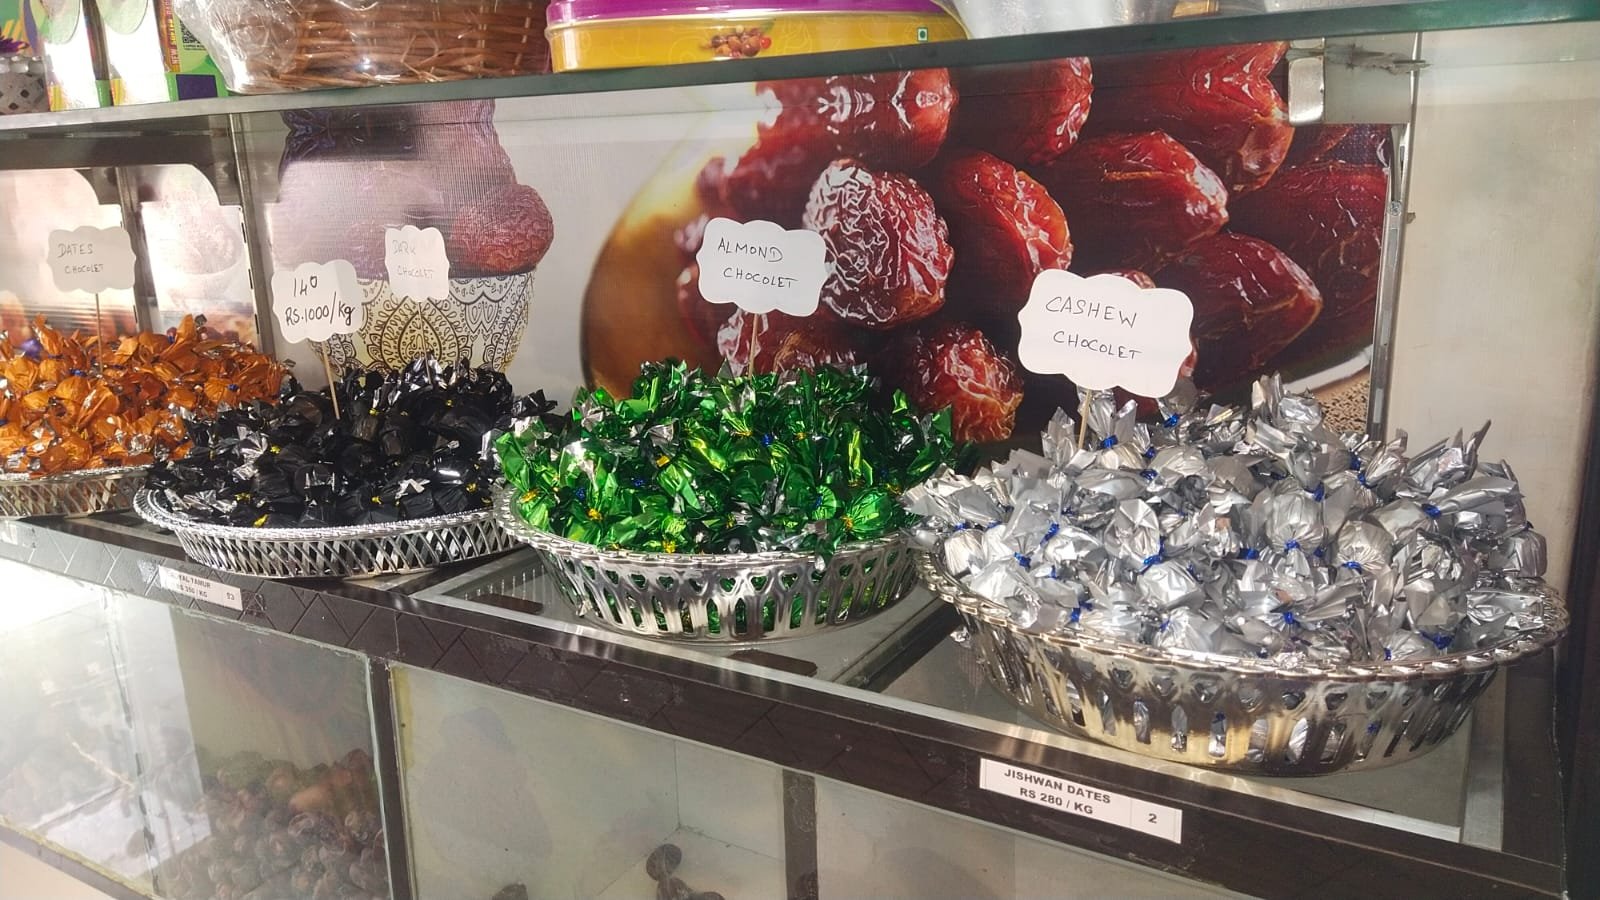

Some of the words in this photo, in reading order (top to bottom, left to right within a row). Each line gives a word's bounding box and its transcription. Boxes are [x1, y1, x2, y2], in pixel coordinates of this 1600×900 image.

[57, 243, 94, 258] DATES
[392, 239, 416, 256] DARK
[717, 236, 784, 263] ALMOND
[64, 264, 104, 274] CHOCOLET
[723, 267, 799, 289] CHOCOLET
[1045, 296, 1138, 328] CASHEW
[1053, 330, 1142, 360] CHOCOLET
[1004, 768, 1063, 792] JISHWAN
[1067, 784, 1111, 804] DATES
[1019, 787, 1037, 800] RS
[1040, 792, 1063, 807] 280
[1074, 801, 1094, 815] KG
[1147, 812, 1158, 824] 2
